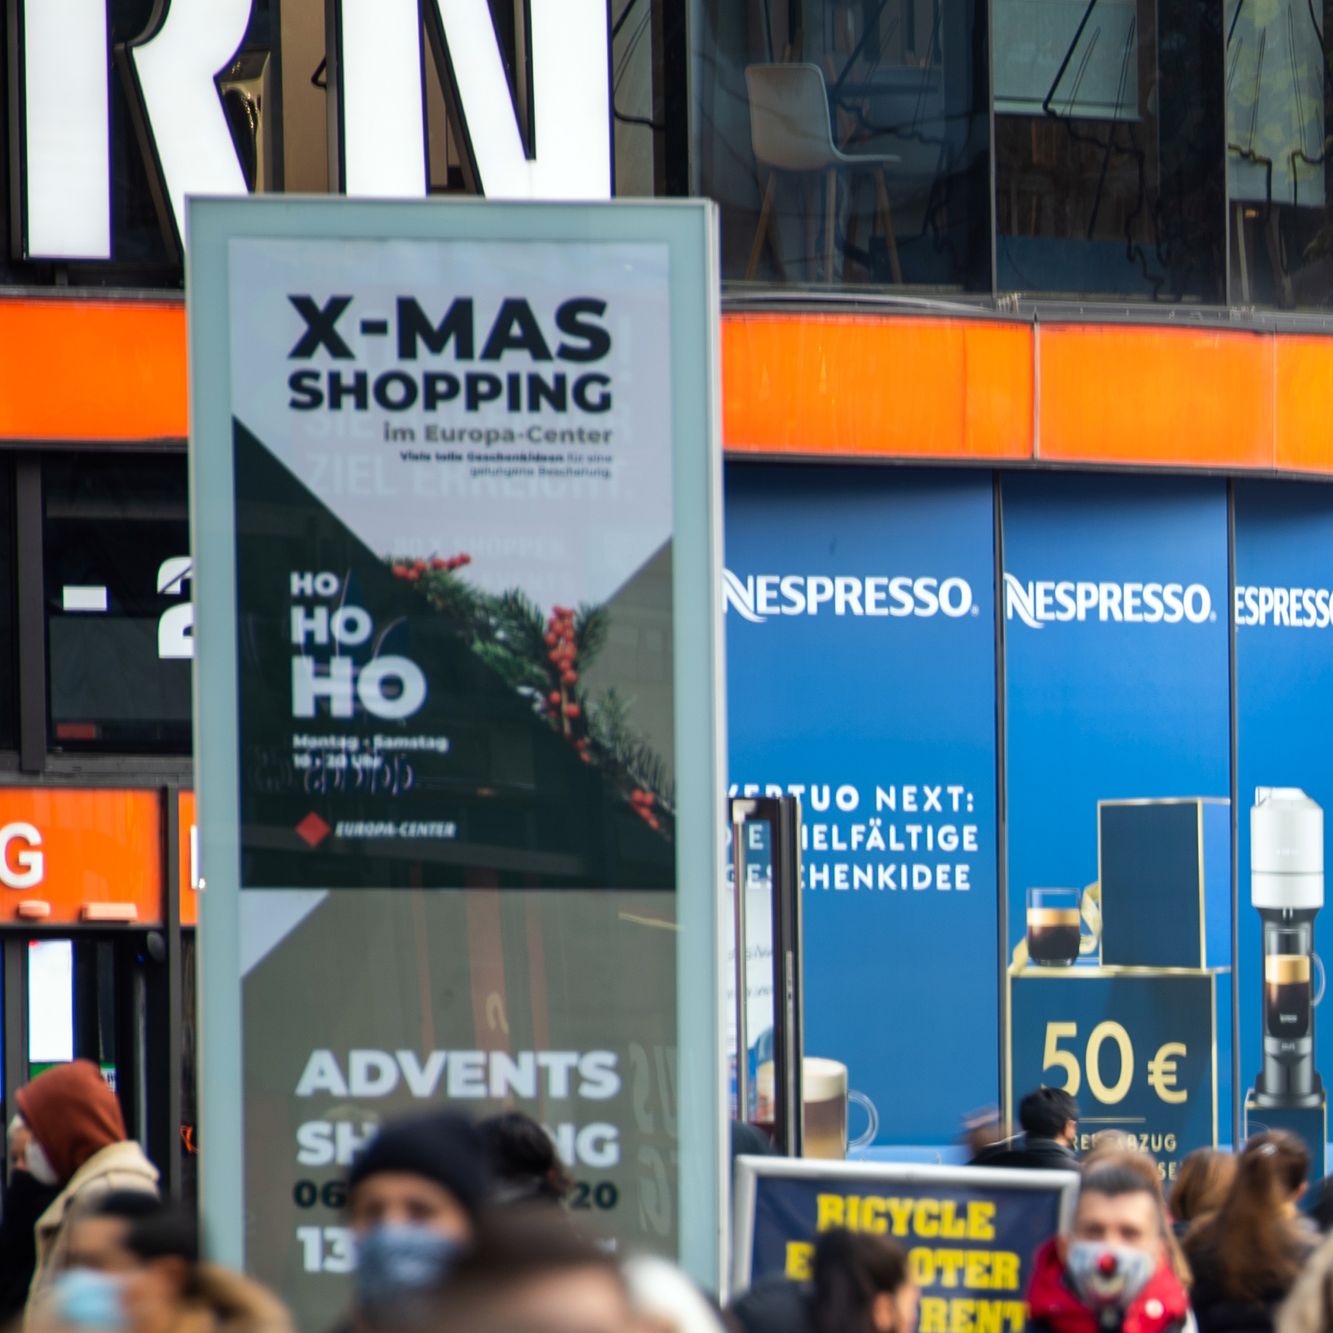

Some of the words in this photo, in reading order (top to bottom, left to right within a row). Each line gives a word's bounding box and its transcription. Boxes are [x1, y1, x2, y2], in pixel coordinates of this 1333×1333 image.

[287, 294, 612, 363] X-MAS
[287, 370, 613, 414] SHOPPING
[384, 422, 416, 443] im
[424, 424, 613, 447] Europa-Center
[291, 572, 338, 597] HO
[722, 568, 980, 623] NESPRESSO
[1003, 573, 1217, 629] NESPRESSO
[291, 605, 373, 646] HO
[292, 654, 428, 720] HO
[876, 785, 974, 812] NEXT:
[335, 821, 456, 838] EUROPA-CENTER
[799, 818, 979, 851] IELFÄLTIGE
[295, 1050, 620, 1099] ADVENTS
[1041, 1020, 1134, 1105] 50
[1147, 1042, 1188, 1104] €
[816, 1193, 996, 1240] BICYCLE
